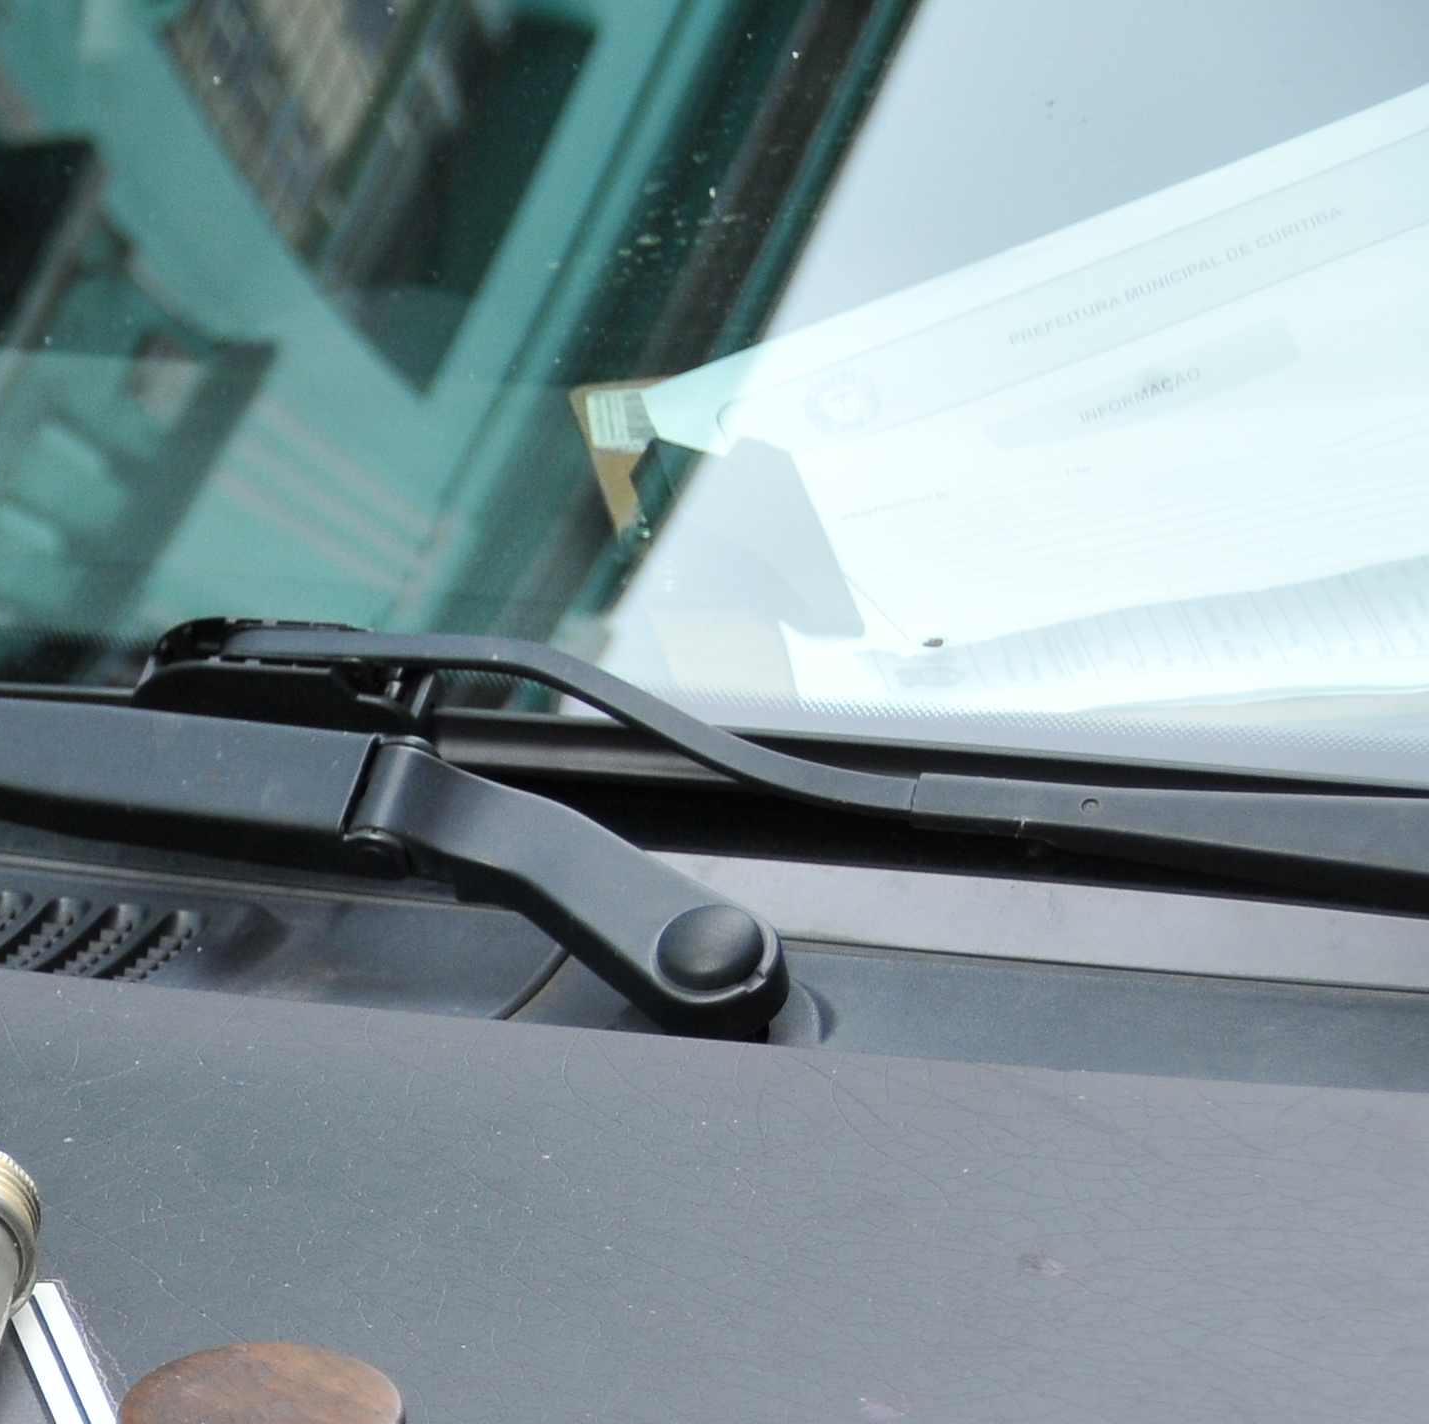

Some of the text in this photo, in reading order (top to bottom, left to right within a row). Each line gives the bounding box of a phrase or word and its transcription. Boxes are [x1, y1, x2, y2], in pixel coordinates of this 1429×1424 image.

[1007, 206, 1344, 346] PREFEITURA MUNICIPAL DE CURITIBA
